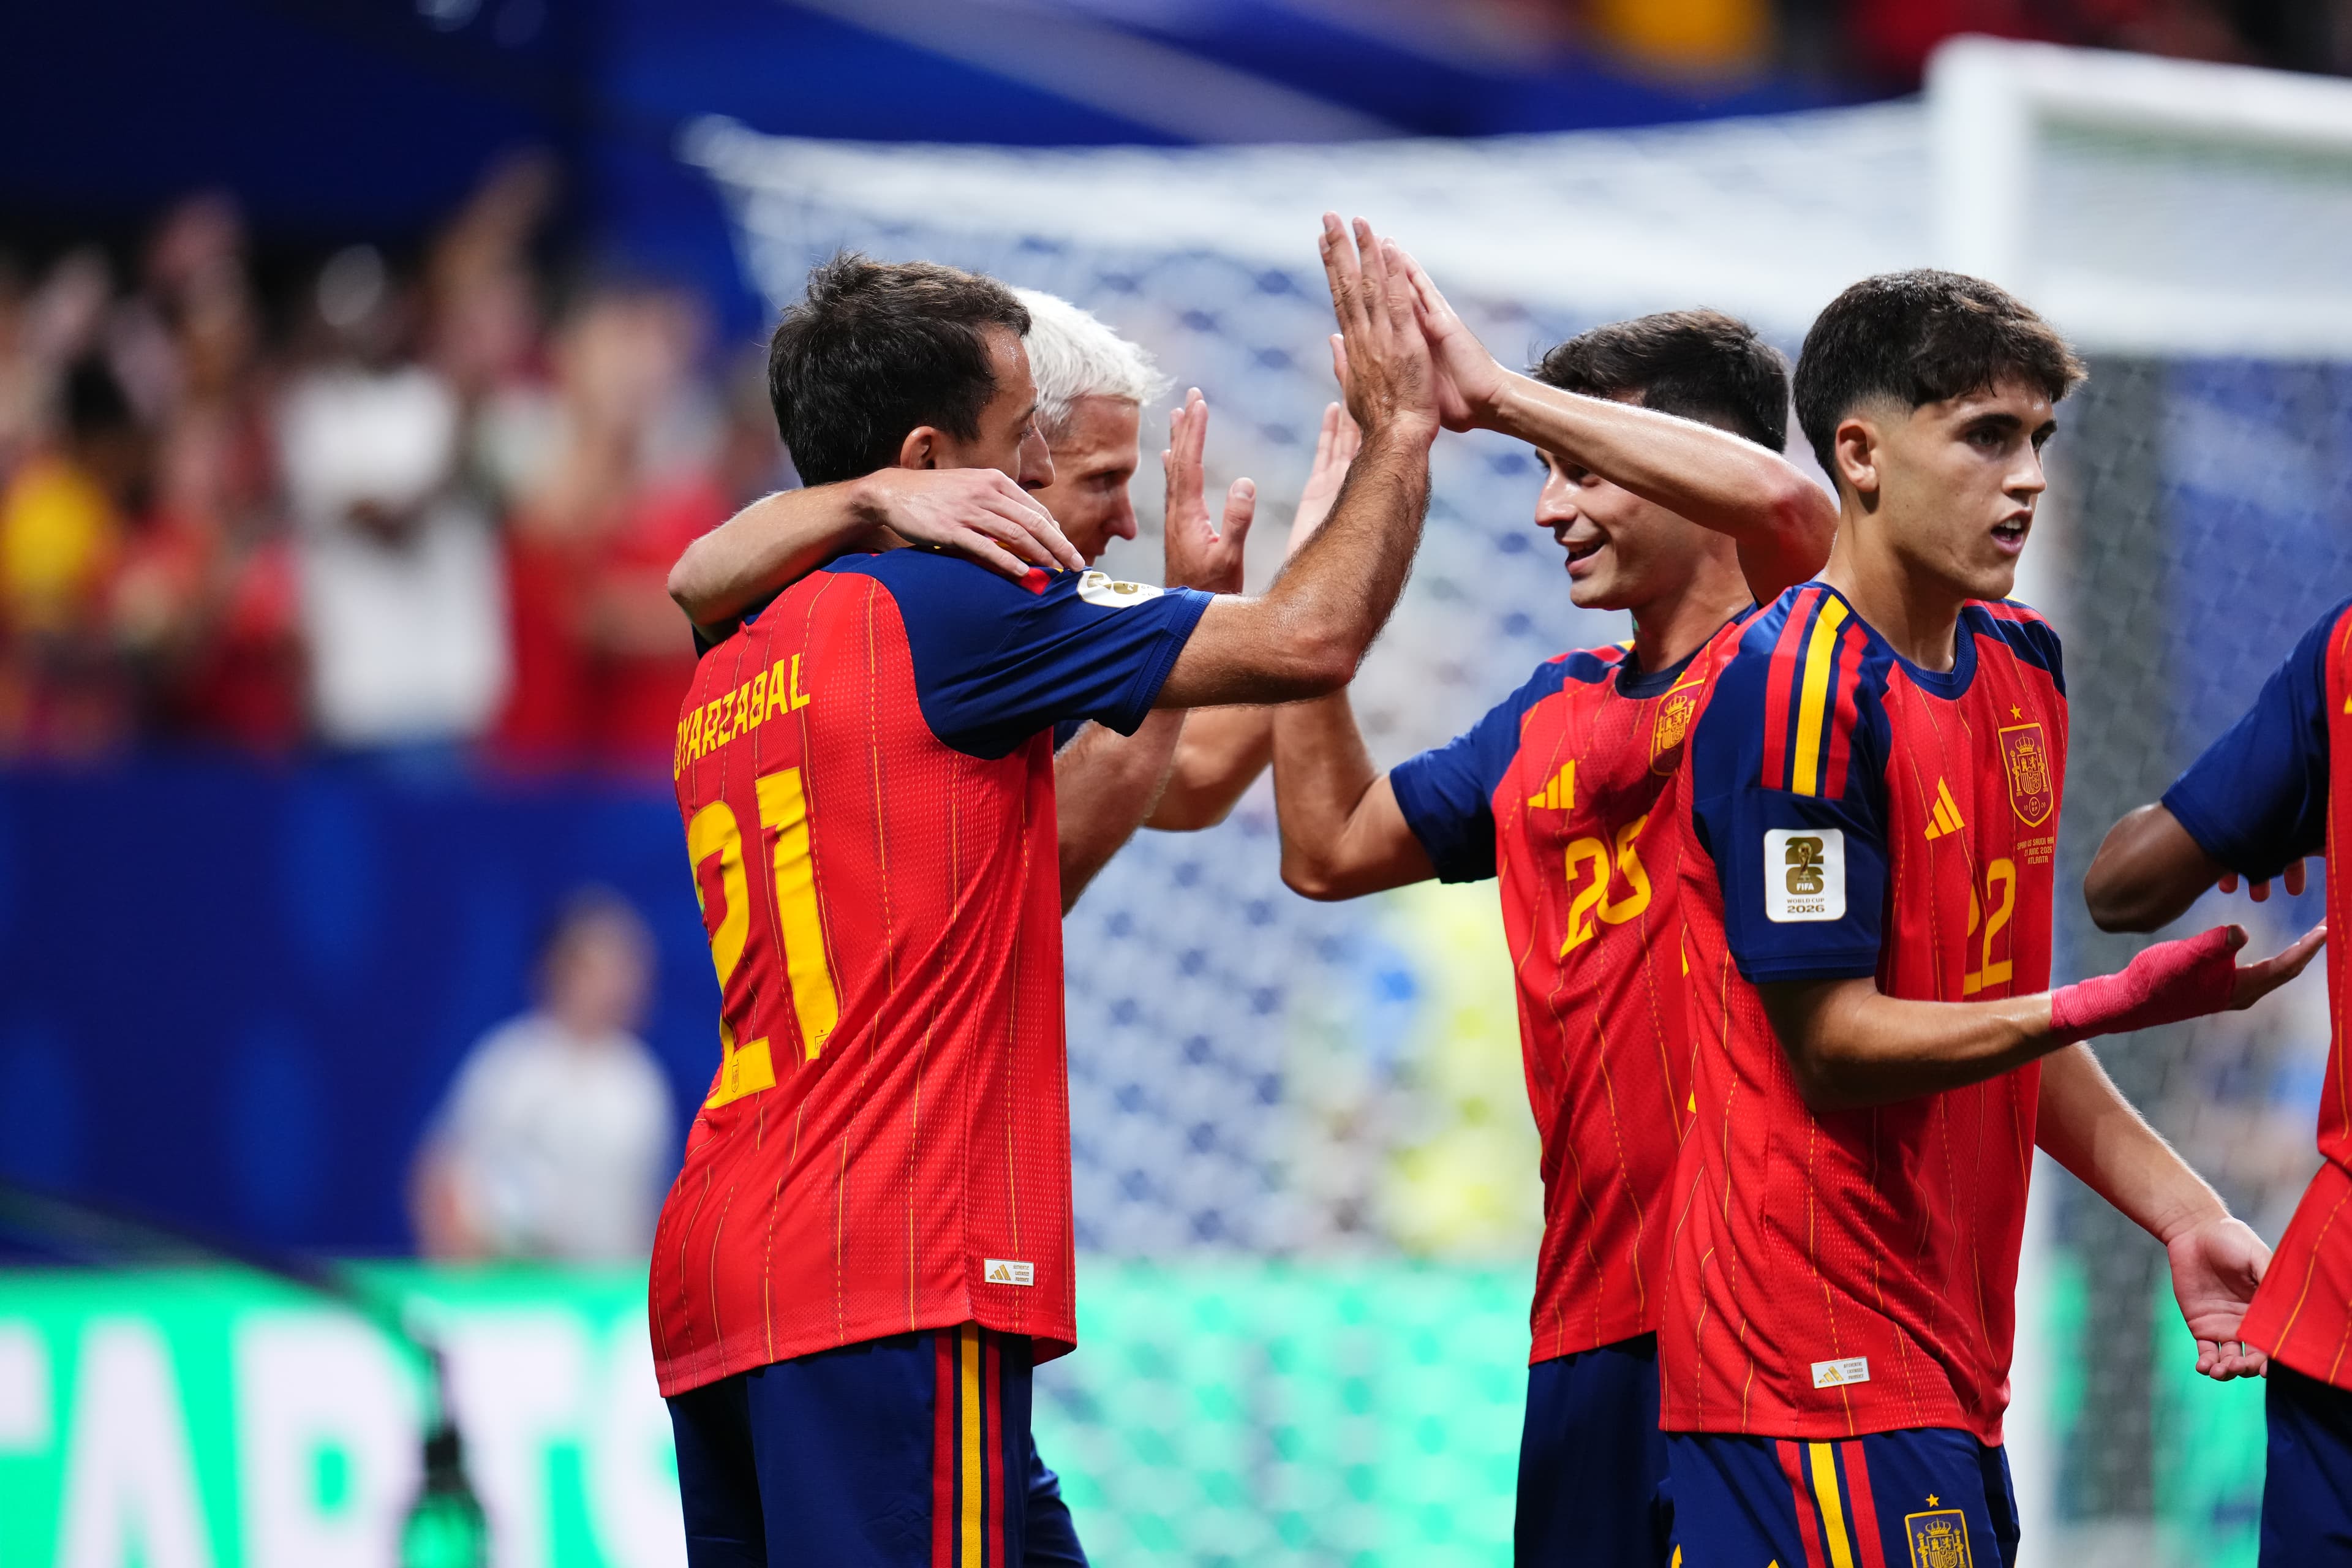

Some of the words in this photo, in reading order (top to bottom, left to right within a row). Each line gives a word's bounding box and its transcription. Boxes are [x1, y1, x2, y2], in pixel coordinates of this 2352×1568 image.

[674, 653, 810, 781] OYARZABAL
[2033, 837, 2046, 846] SAUDI
[2040, 845, 2052, 854] 2026
[2027, 856, 2048, 865] ATLANTA
[1559, 815, 1652, 958] 26
[1796, 883, 1814, 891] FIFA
[1787, 905, 1825, 913] 2026
[688, 766, 839, 1109] 21
